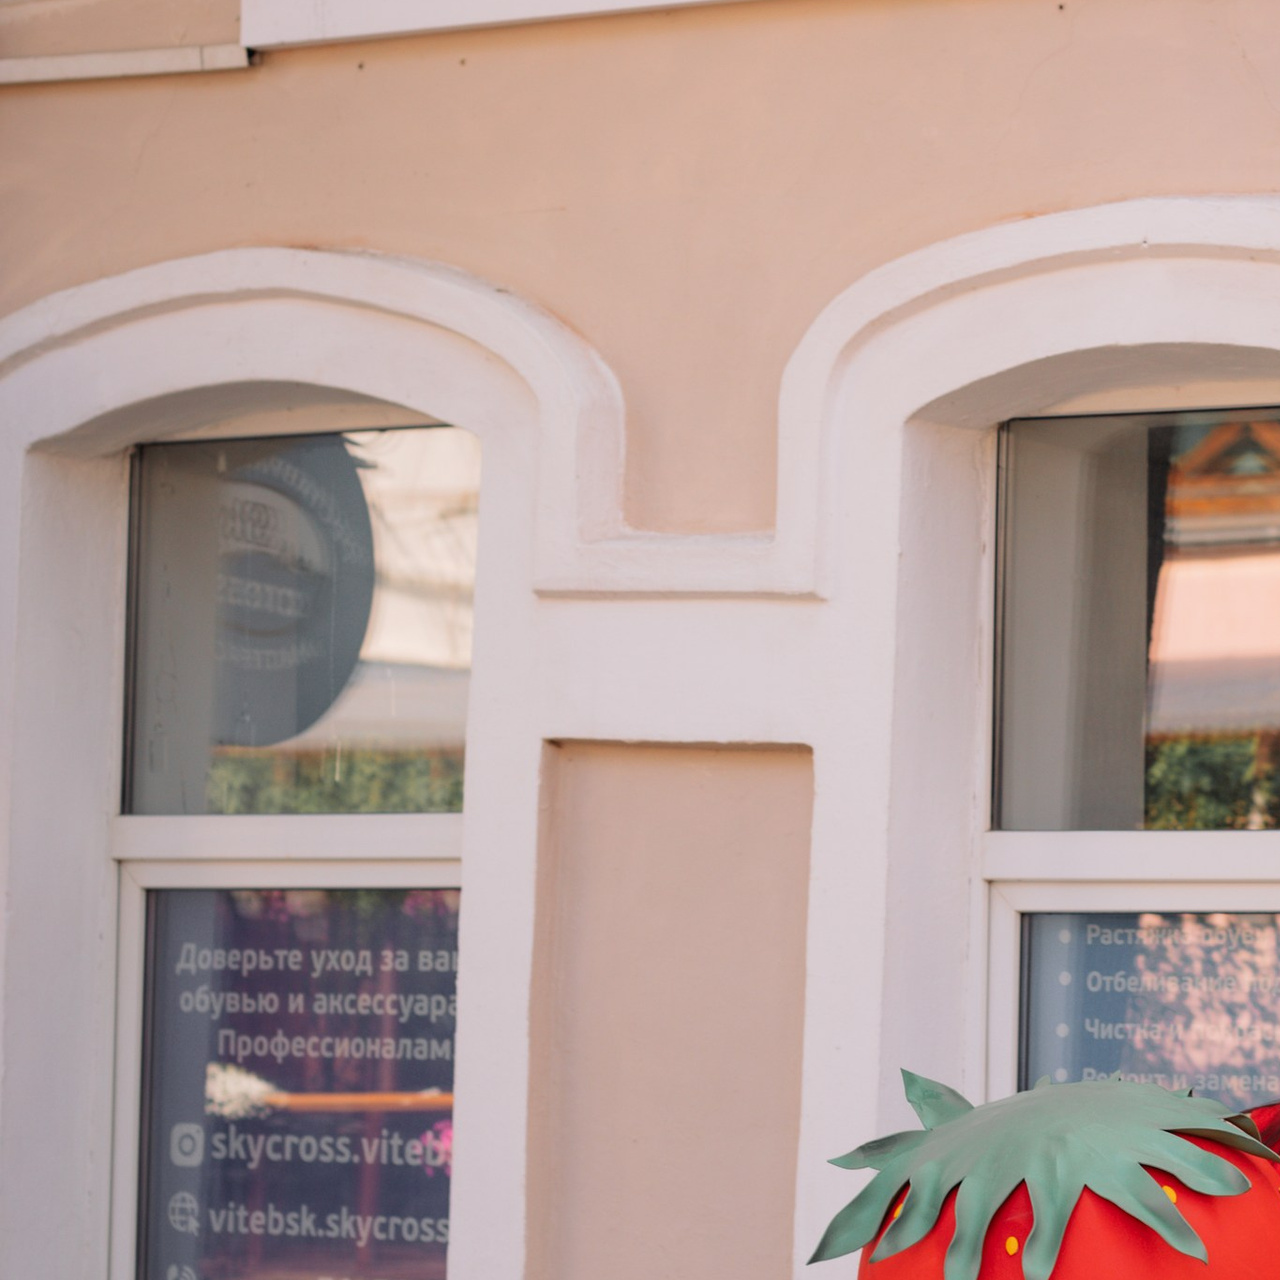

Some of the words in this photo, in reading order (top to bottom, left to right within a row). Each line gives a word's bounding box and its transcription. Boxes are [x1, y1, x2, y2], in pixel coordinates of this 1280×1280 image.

[176, 943, 301, 976] Доверьте
[311, 948, 372, 977] уход
[380, 948, 409, 972] за
[1086, 971, 1236, 993] Отбеливание
[180, 986, 279, 1019] обувью
[288, 992, 304, 1014] и
[1084, 1018, 1162, 1040] Чистка
[1172, 1073, 1188, 1091] и
[1195, 1073, 1280, 1093] замена
[211, 1126, 453, 1170] skycross.viteb
[209, 1204, 450, 1247] vitebsk.skycross
